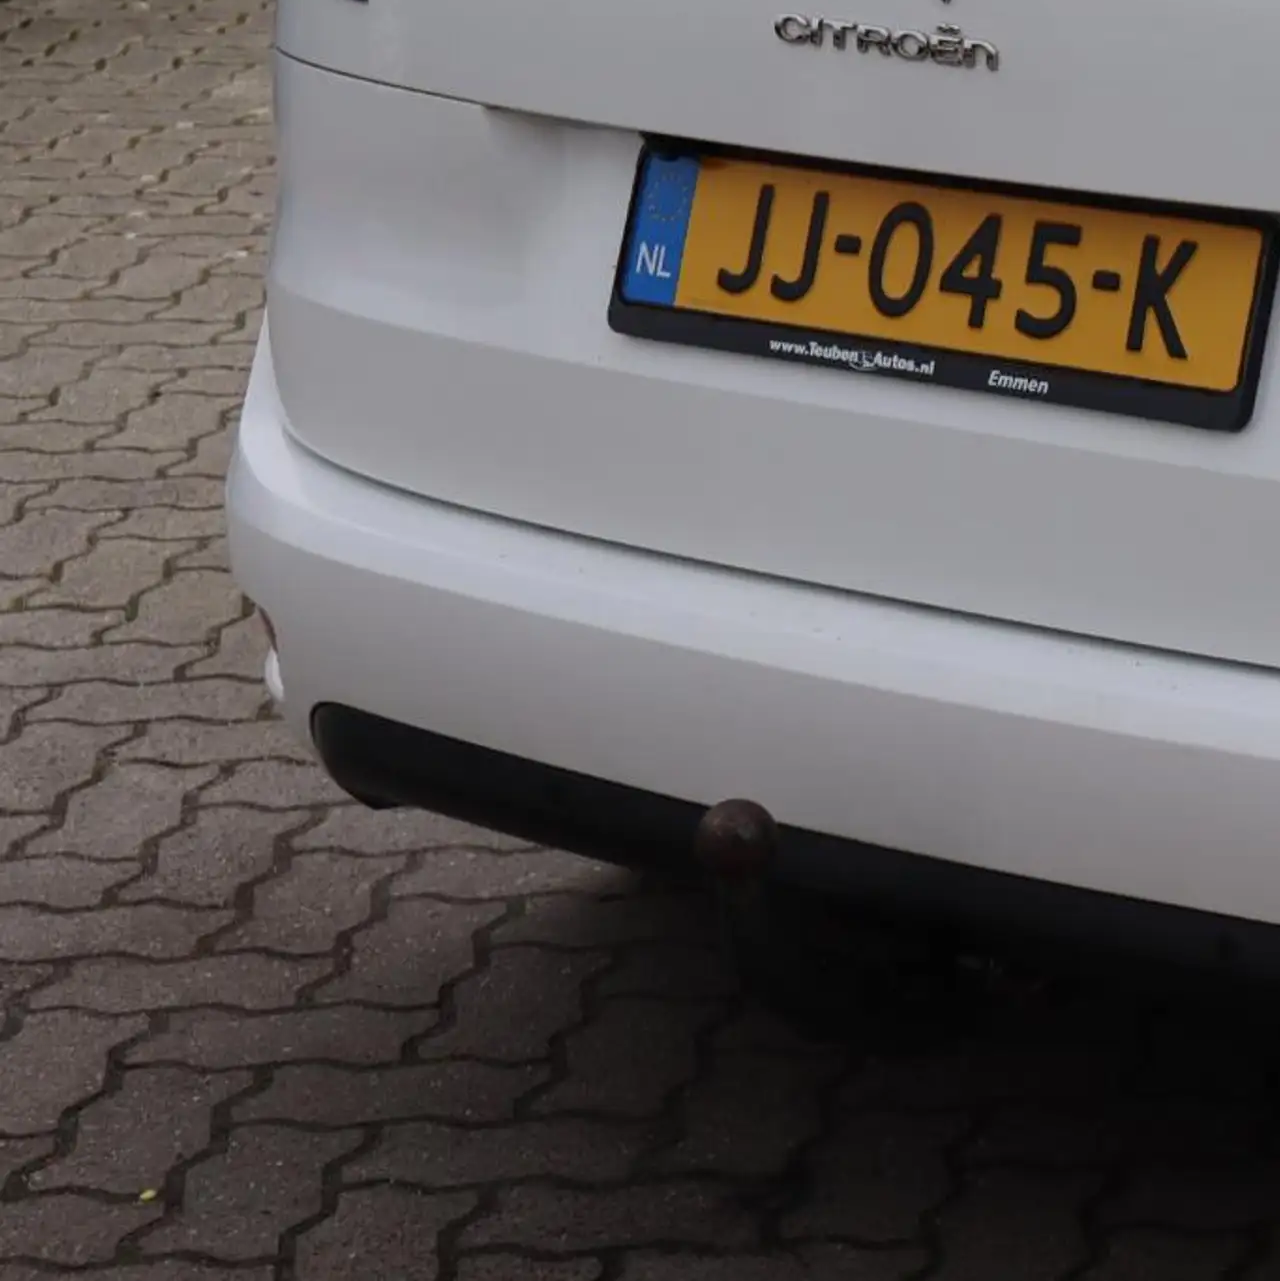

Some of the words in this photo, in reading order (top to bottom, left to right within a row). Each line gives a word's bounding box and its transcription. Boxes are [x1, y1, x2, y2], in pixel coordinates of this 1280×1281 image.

[635, 241, 671, 279] NL
[717, 183, 1198, 360] JJ-045-K
[987, 369, 1049, 394] Emmen
